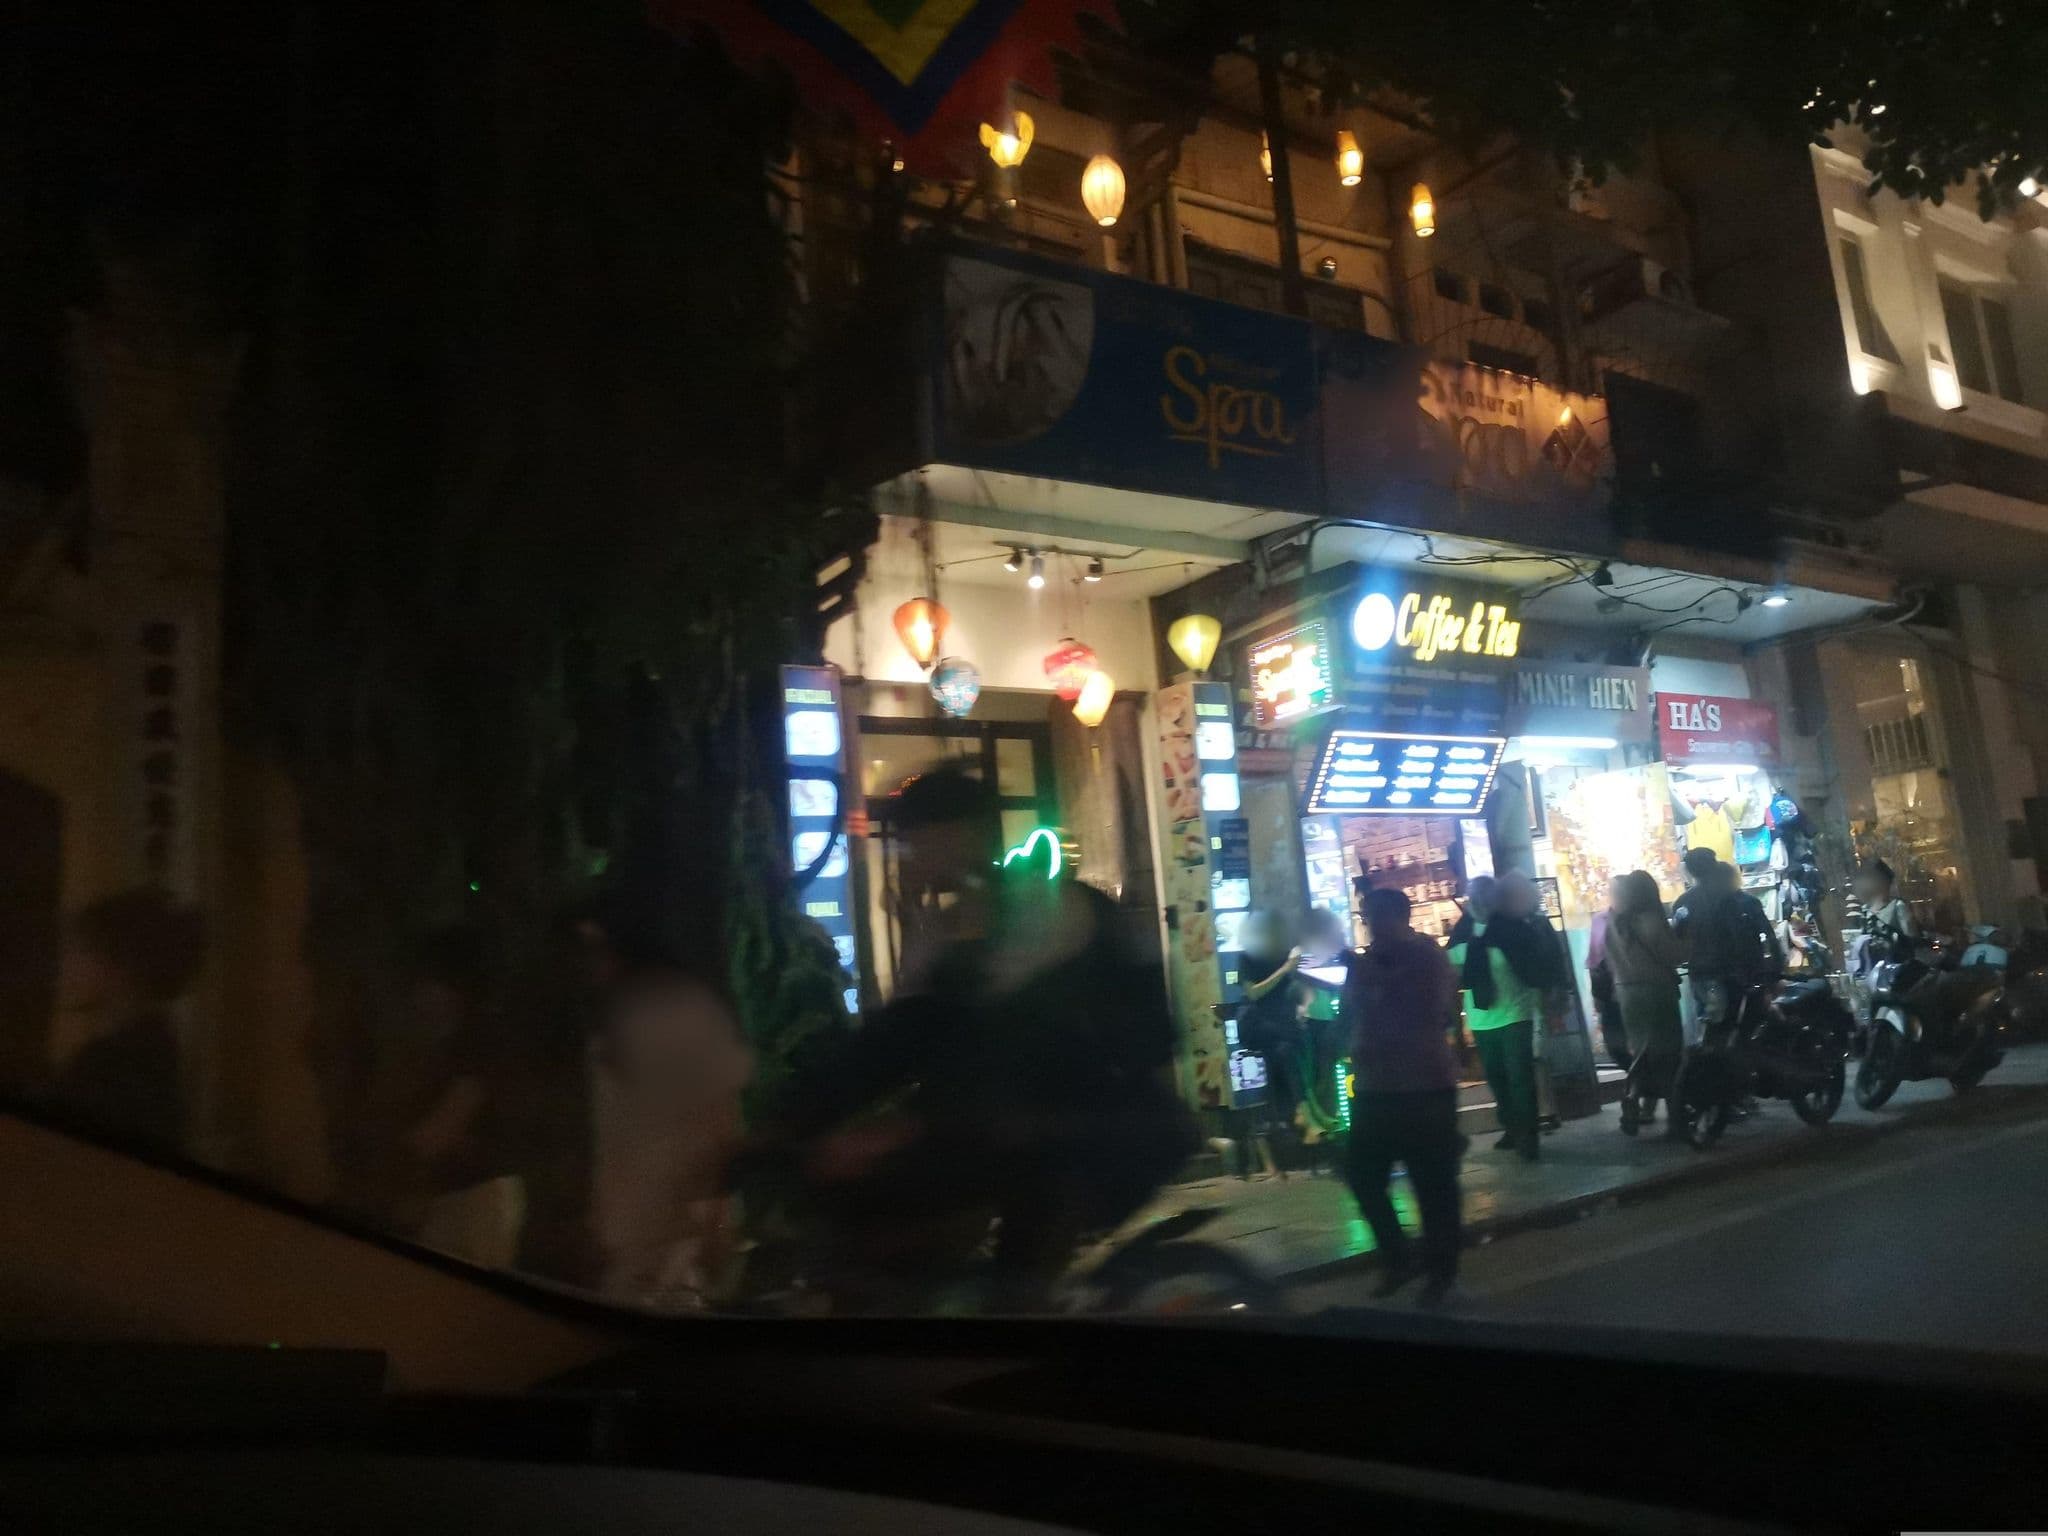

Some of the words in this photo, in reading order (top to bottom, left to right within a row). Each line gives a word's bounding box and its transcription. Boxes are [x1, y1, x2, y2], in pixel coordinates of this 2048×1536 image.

[1159, 346, 1296, 470] Spa
[1396, 592, 1465, 661] Coffee
[1463, 602, 1486, 653] &
[1518, 671, 1577, 707] MINH
[1589, 677, 1638, 711] HIEN
